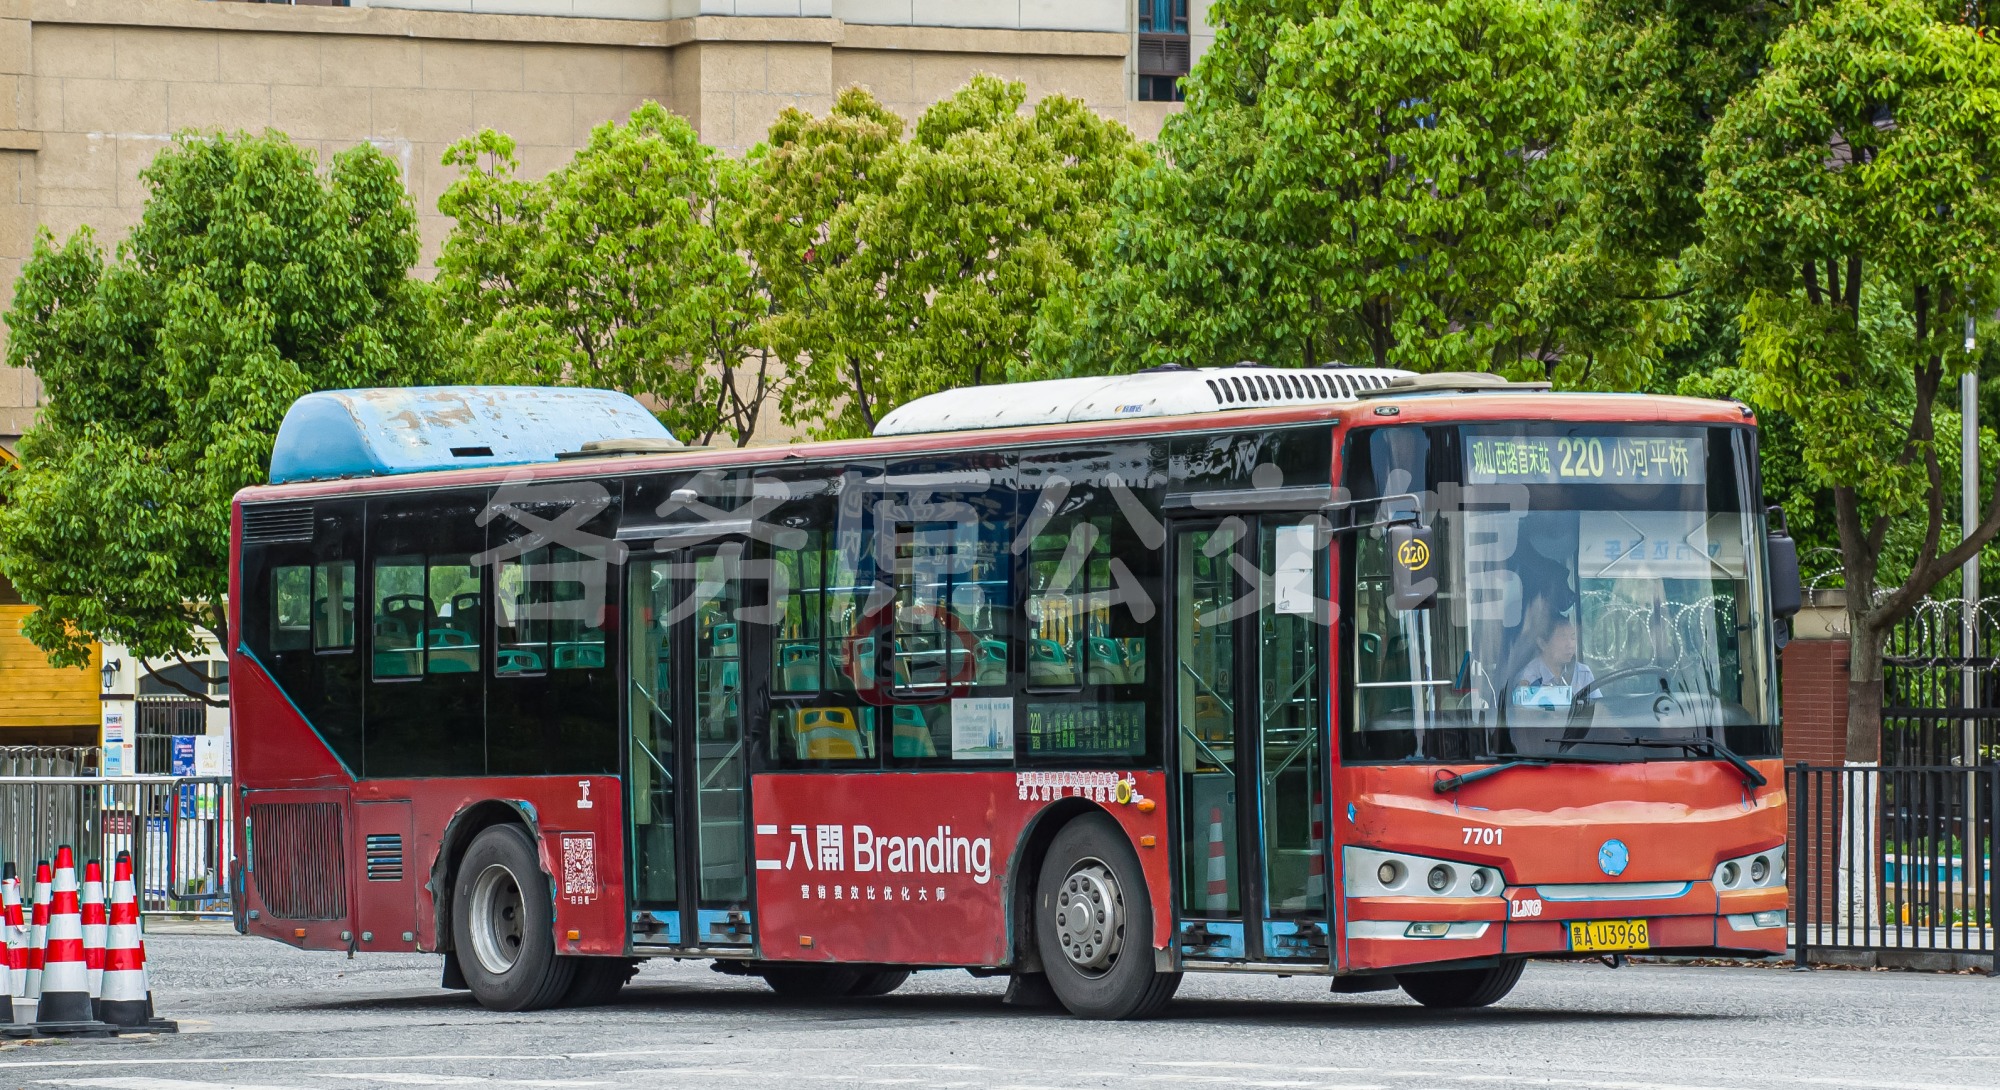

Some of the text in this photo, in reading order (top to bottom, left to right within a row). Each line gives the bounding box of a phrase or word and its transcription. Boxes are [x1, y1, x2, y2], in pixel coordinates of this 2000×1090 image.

[1472, 437, 1689, 477] 观山西路首末站 220 小河平桥
[1403, 545, 1424, 563] 220
[1030, 712, 1042, 734] 220
[1462, 827, 1503, 846] 7701
[756, 824, 991, 884] 二八開 Branding
[800, 884, 946, 902] 营销费效比优化大师
[1512, 899, 1542, 917] LNG
